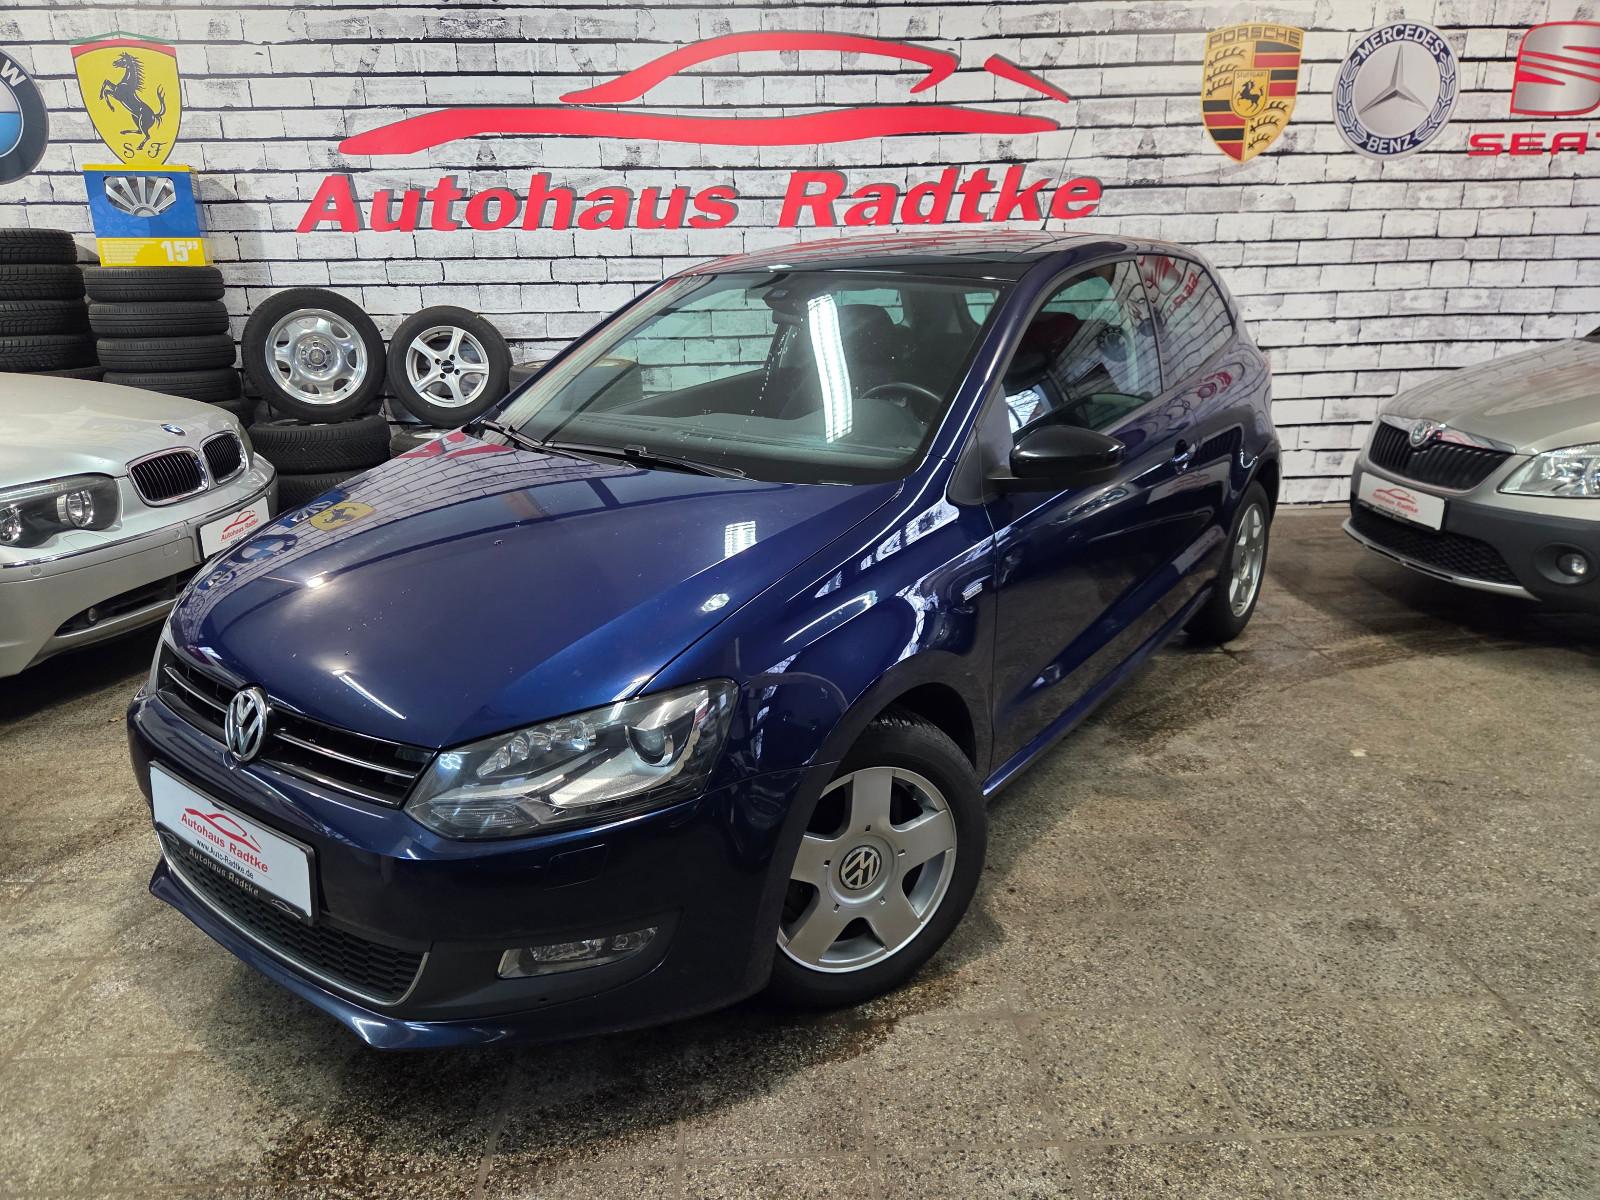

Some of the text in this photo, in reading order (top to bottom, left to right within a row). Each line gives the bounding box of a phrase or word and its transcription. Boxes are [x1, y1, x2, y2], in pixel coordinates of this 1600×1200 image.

[1209, 27, 1300, 48] PORSCHE
[1357, 25, 1444, 58] MERCEDES
[123, 142, 135, 159] S
[1367, 135, 1414, 152] BENZ
[1467, 132, 1600, 157] SEA
[296, 164, 1103, 233] Autohaus Radtke
[181, 813, 269, 873] Autohaus Radtke
[188, 848, 259, 896] Autohaus Radtke
